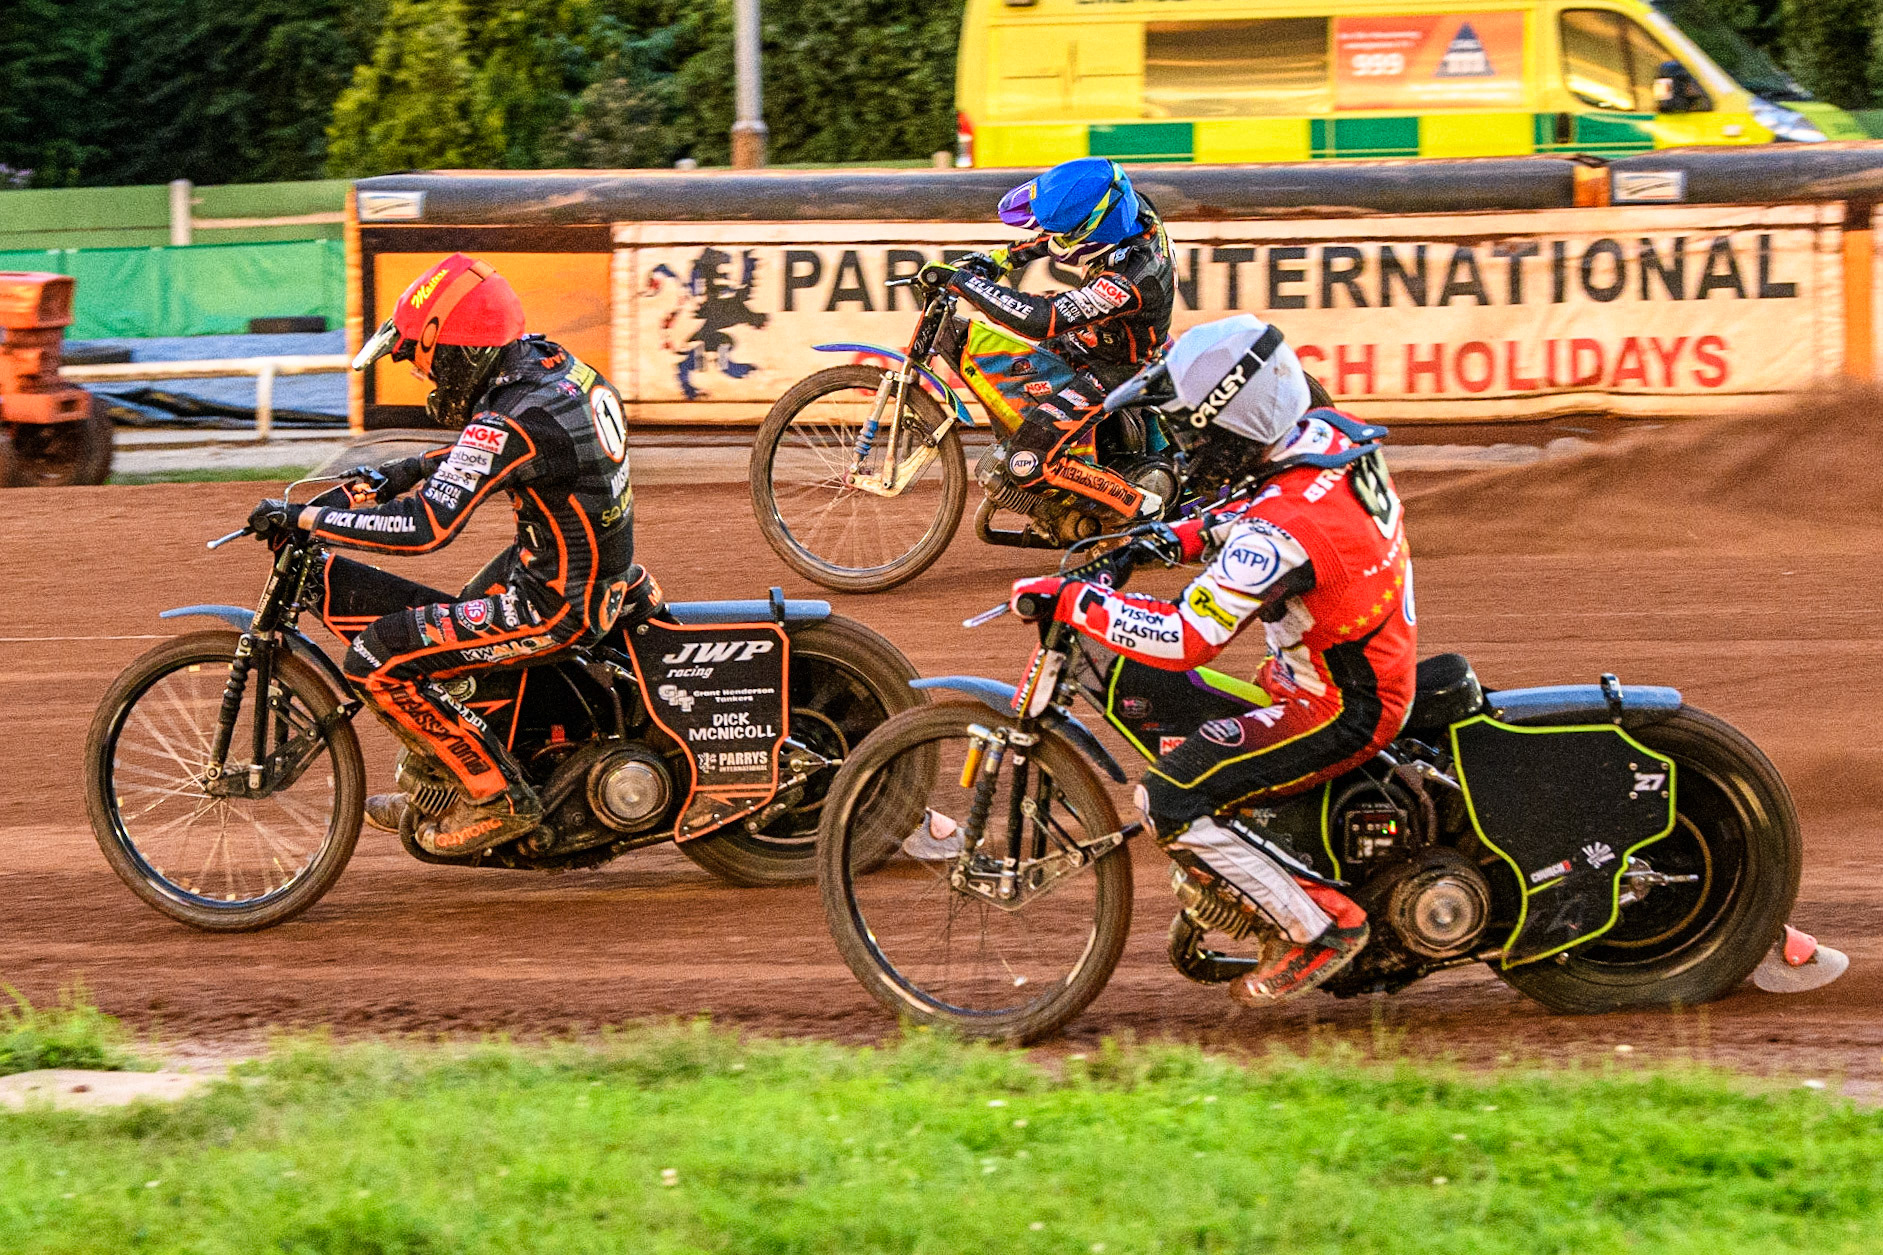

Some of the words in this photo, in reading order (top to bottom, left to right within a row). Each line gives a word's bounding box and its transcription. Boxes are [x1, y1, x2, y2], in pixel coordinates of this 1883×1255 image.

[1352, 52, 1405, 76] 999
[783, 250, 1092, 313] PARS
[1172, 231, 1799, 311] NTERNATIONAL
[1095, 278, 1129, 304] NGK
[1053, 300, 1076, 323] SKIPS
[1404, 334, 1732, 394] HOLIDAYS
[1025, 382, 1050, 394] NGK
[1189, 364, 1247, 429] OAKLEY
[462, 426, 504, 447] NGK
[1013, 459, 1033, 469] ATPI
[324, 511, 354, 528] DICK
[354, 513, 417, 534] MCNICOLL
[1228, 548, 1270, 571] ATPI
[1120, 604, 1164, 627] VISION
[1111, 632, 1136, 649] LTD
[1113, 618, 1180, 644] PLASTICS
[662, 640, 775, 664] JWP
[666, 665, 714, 679] racing
[693, 690, 721, 698] Grant
[722, 687, 776, 697] Henderson
[714, 695, 754, 704] Tankers
[712, 712, 750, 727] DICK
[688, 725, 777, 742] MCNICOLL
[718, 751, 769, 767] PARRYS
[1633, 772, 1667, 792] 27
[434, 817, 504, 849] Guytone
